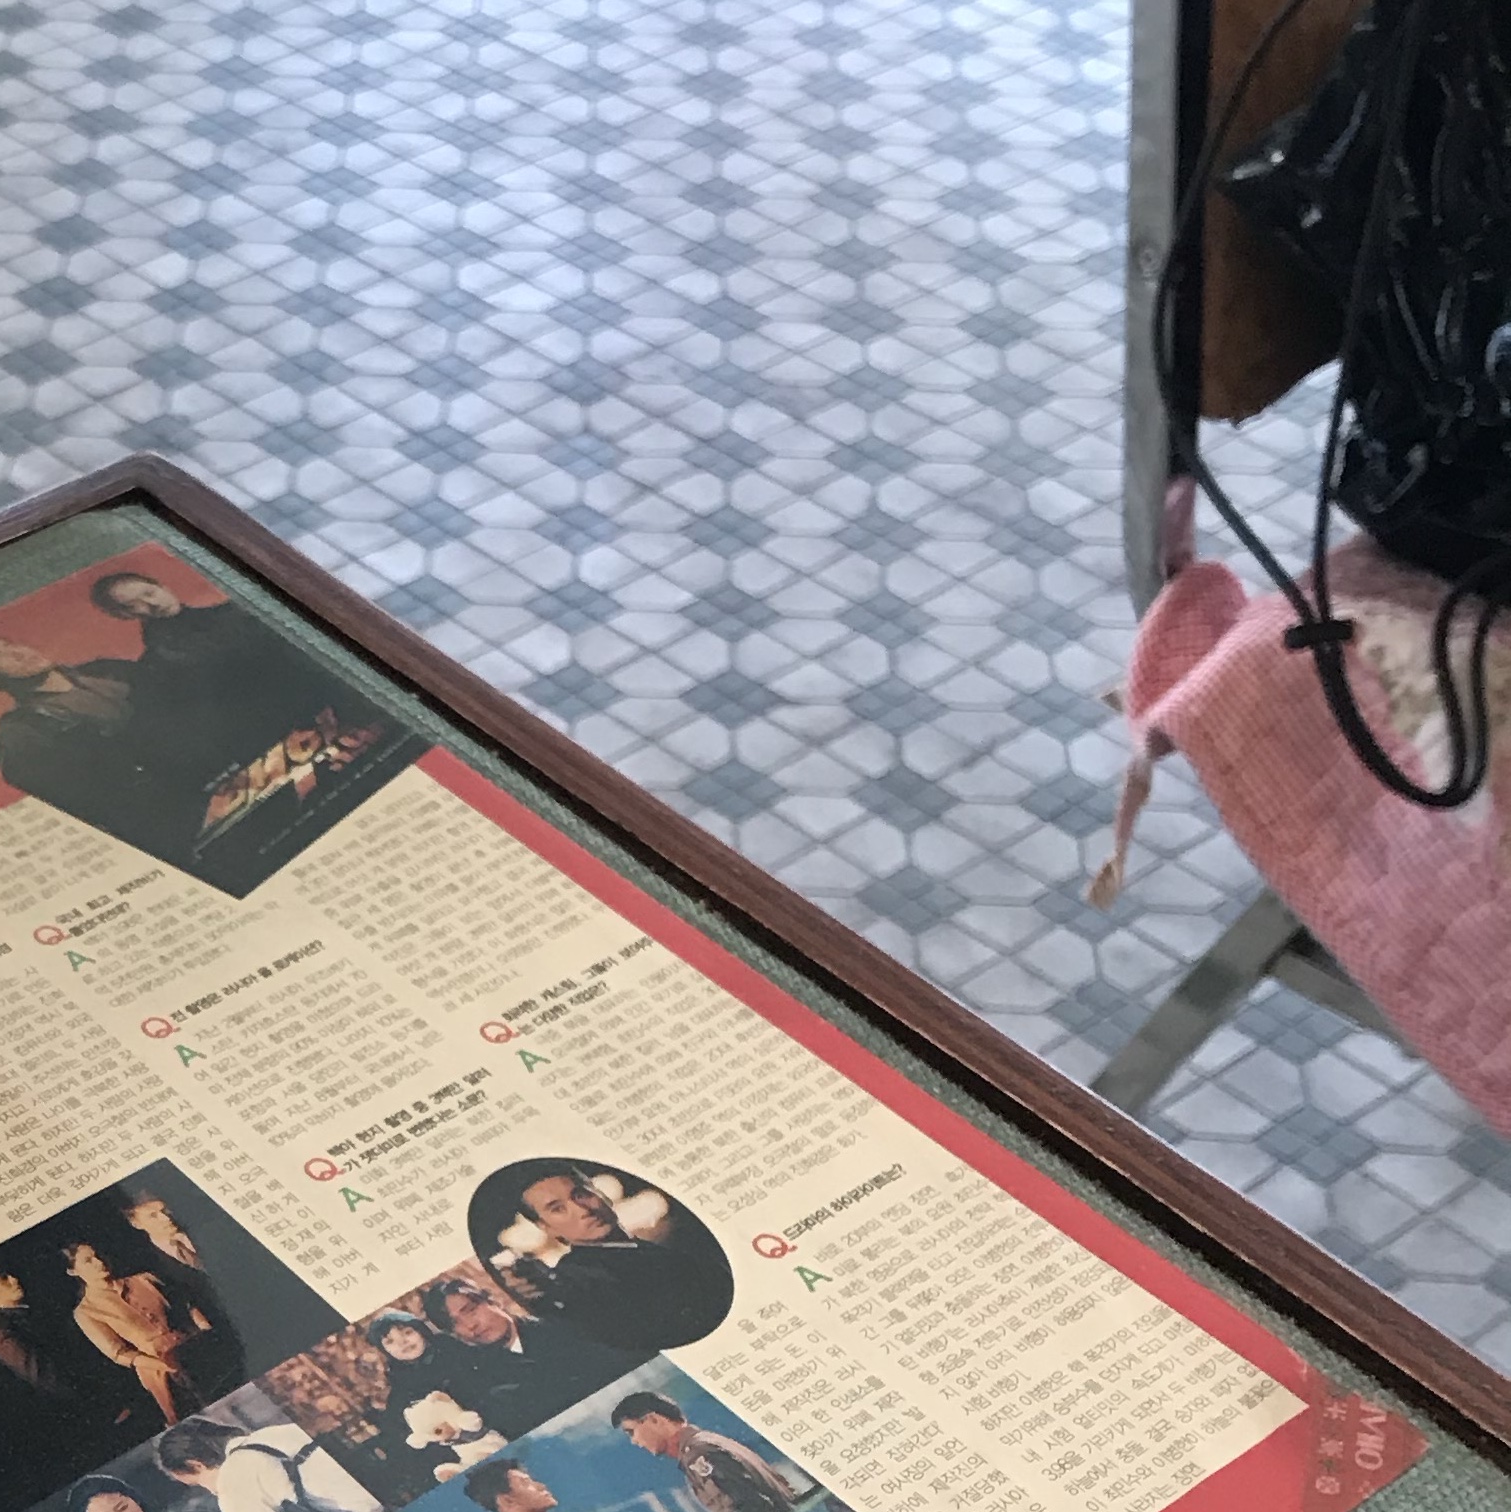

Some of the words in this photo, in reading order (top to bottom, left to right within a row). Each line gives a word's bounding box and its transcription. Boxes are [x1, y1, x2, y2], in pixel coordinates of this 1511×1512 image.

[32, 924, 73, 947] Q
[62, 950, 97, 973] A
[140, 1016, 182, 1040] Q
[479, 1020, 521, 1045] Q
[173, 1044, 208, 1068] A
[515, 1048, 552, 1074] A
[303, 1156, 346, 1182] Q
[337, 1186, 375, 1213] A
[751, 1233, 799, 1259] Q
[792, 1265, 834, 1293] A
